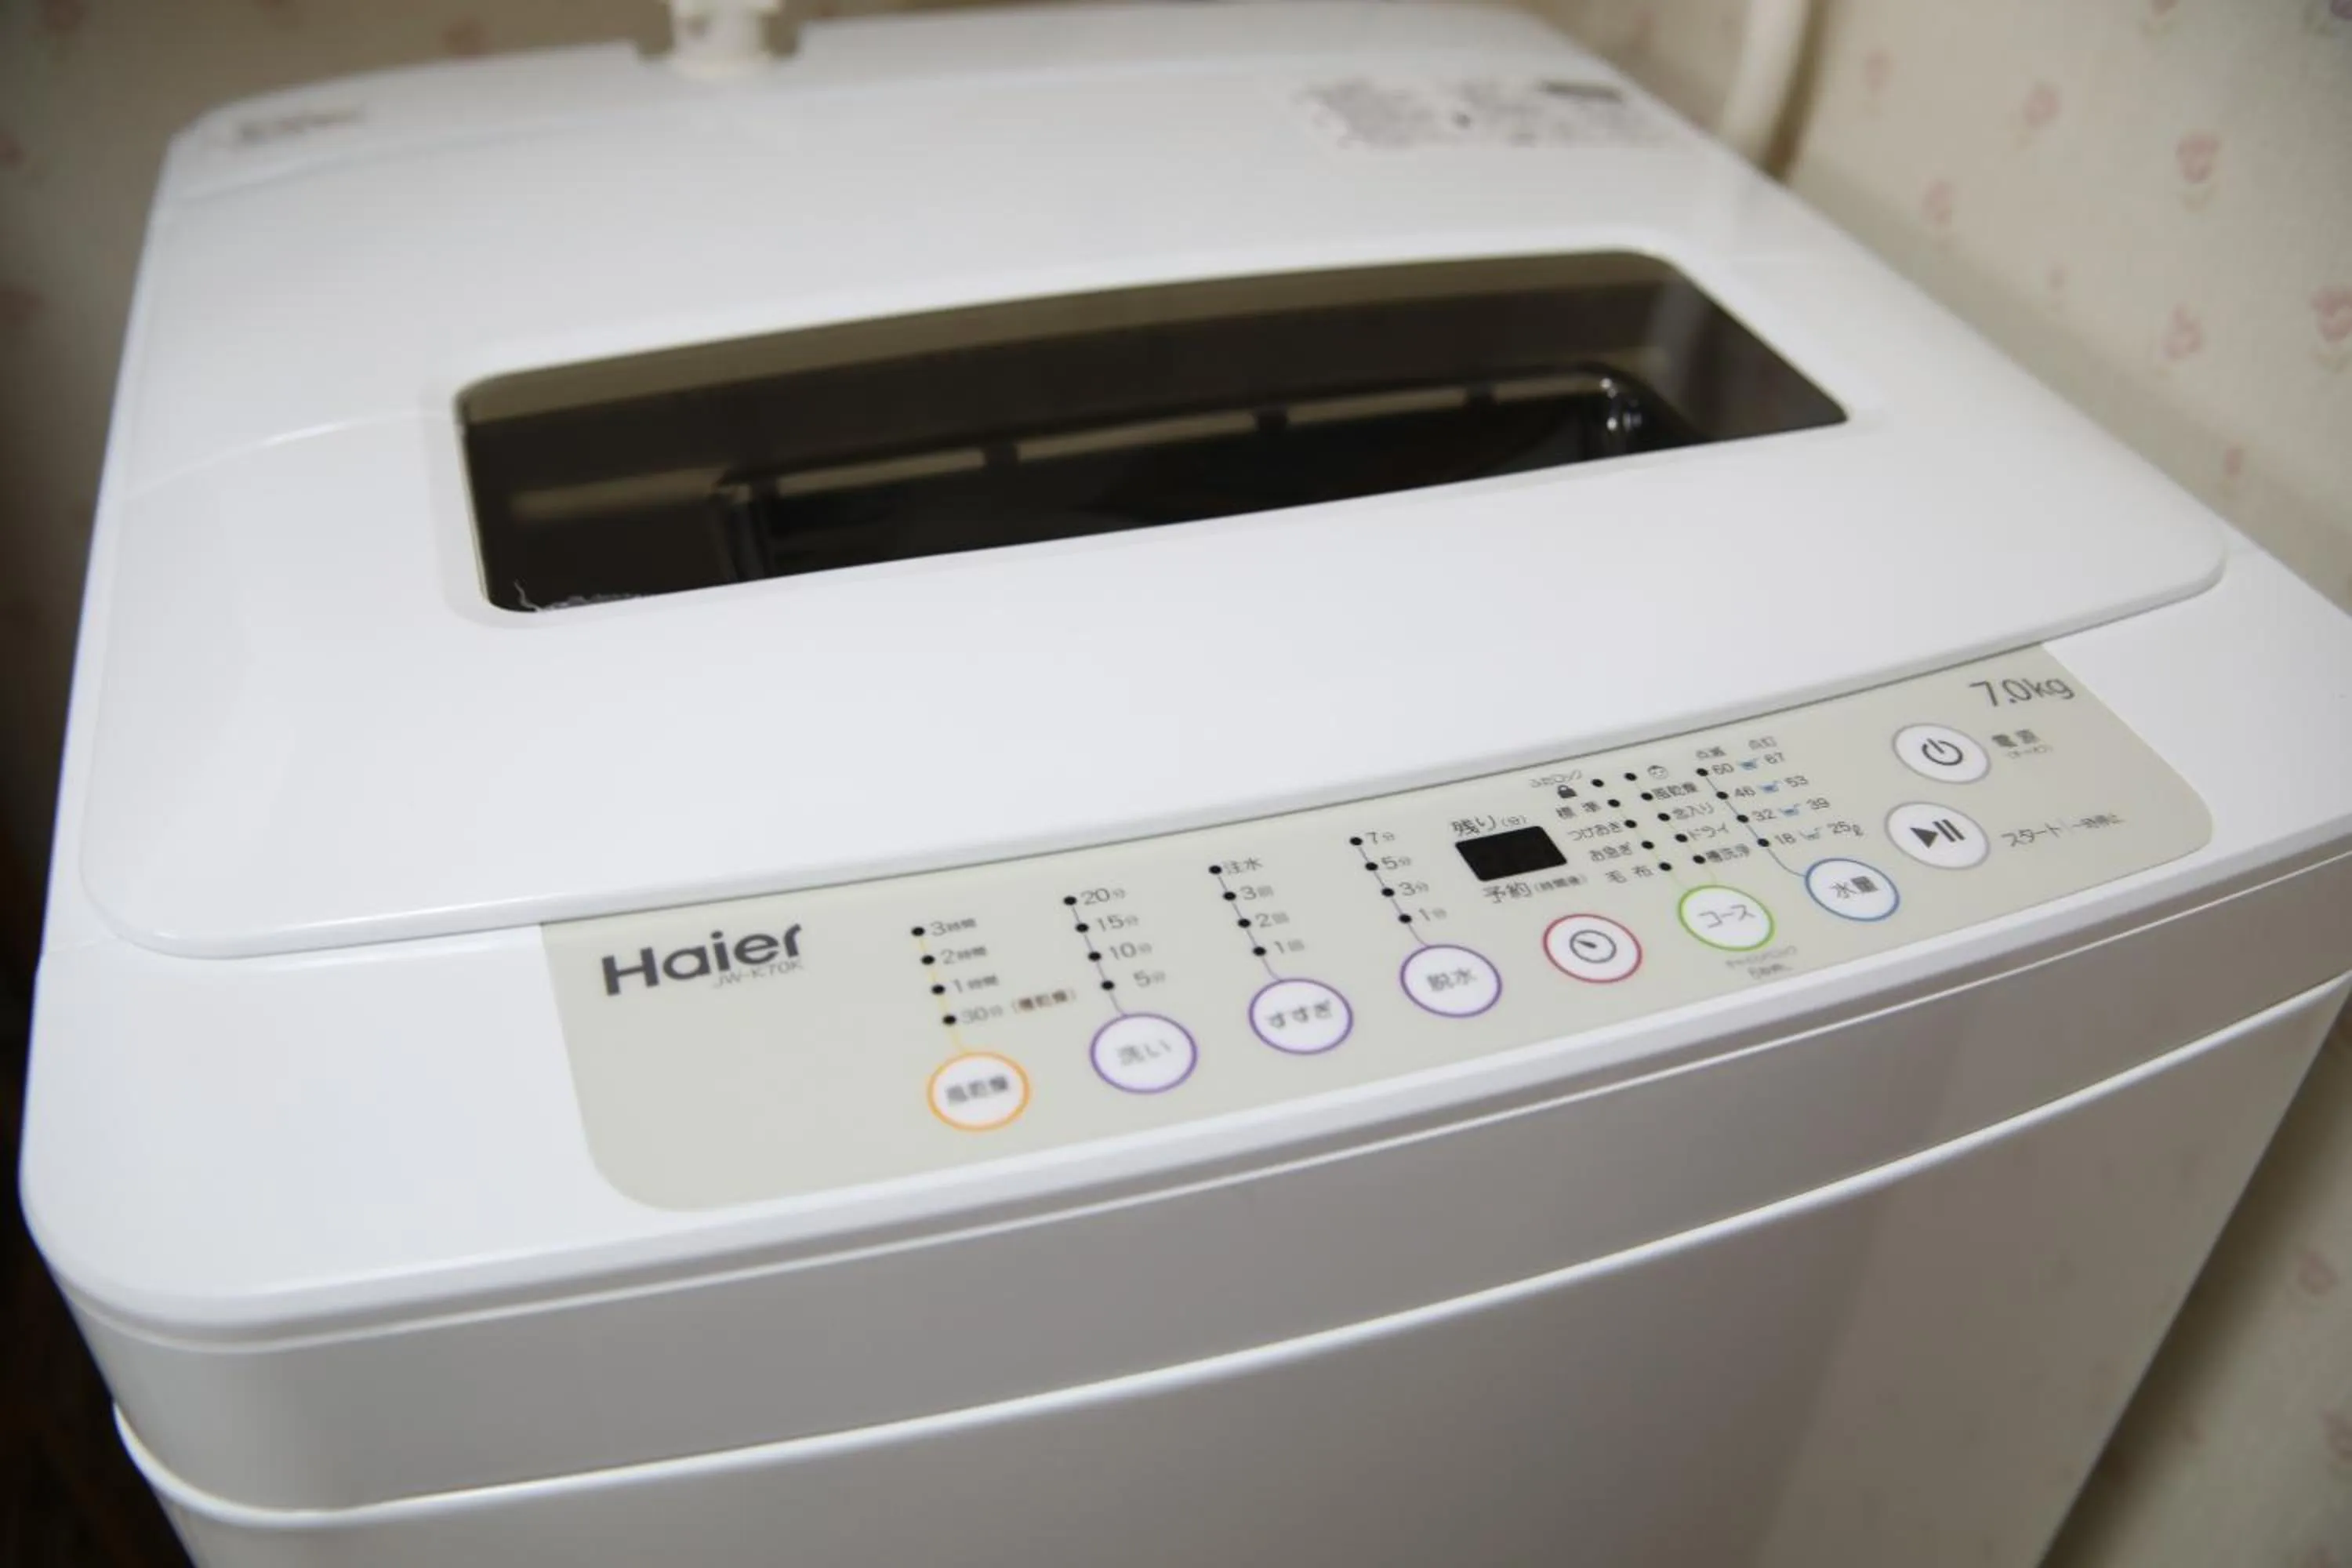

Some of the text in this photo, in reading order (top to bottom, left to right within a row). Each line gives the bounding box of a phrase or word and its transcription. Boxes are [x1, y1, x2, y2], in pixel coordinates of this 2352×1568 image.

[1969, 678, 2076, 707] 7.0kg
[1752, 808, 1777, 822] 32
[1698, 904, 1757, 929] コース
[601, 923, 802, 996] Haier
